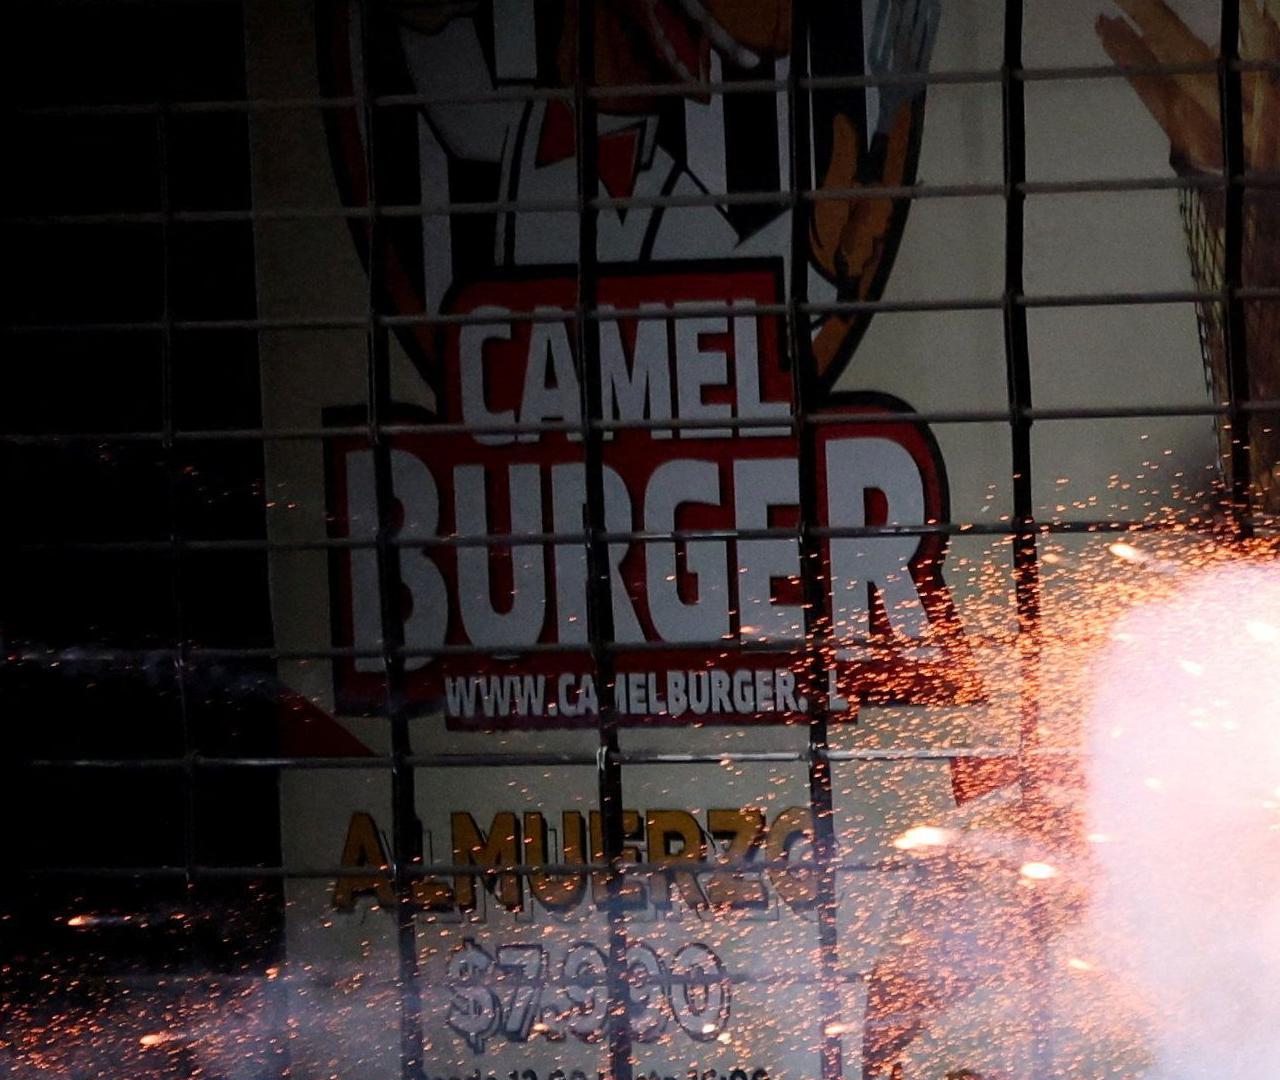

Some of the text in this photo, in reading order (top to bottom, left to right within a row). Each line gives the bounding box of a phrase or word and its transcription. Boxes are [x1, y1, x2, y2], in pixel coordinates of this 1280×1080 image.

[457, 298, 790, 446] CAMEL
[345, 436, 935, 673] BURGER
[445, 668, 849, 718] WWW.CAELBURGER.L
